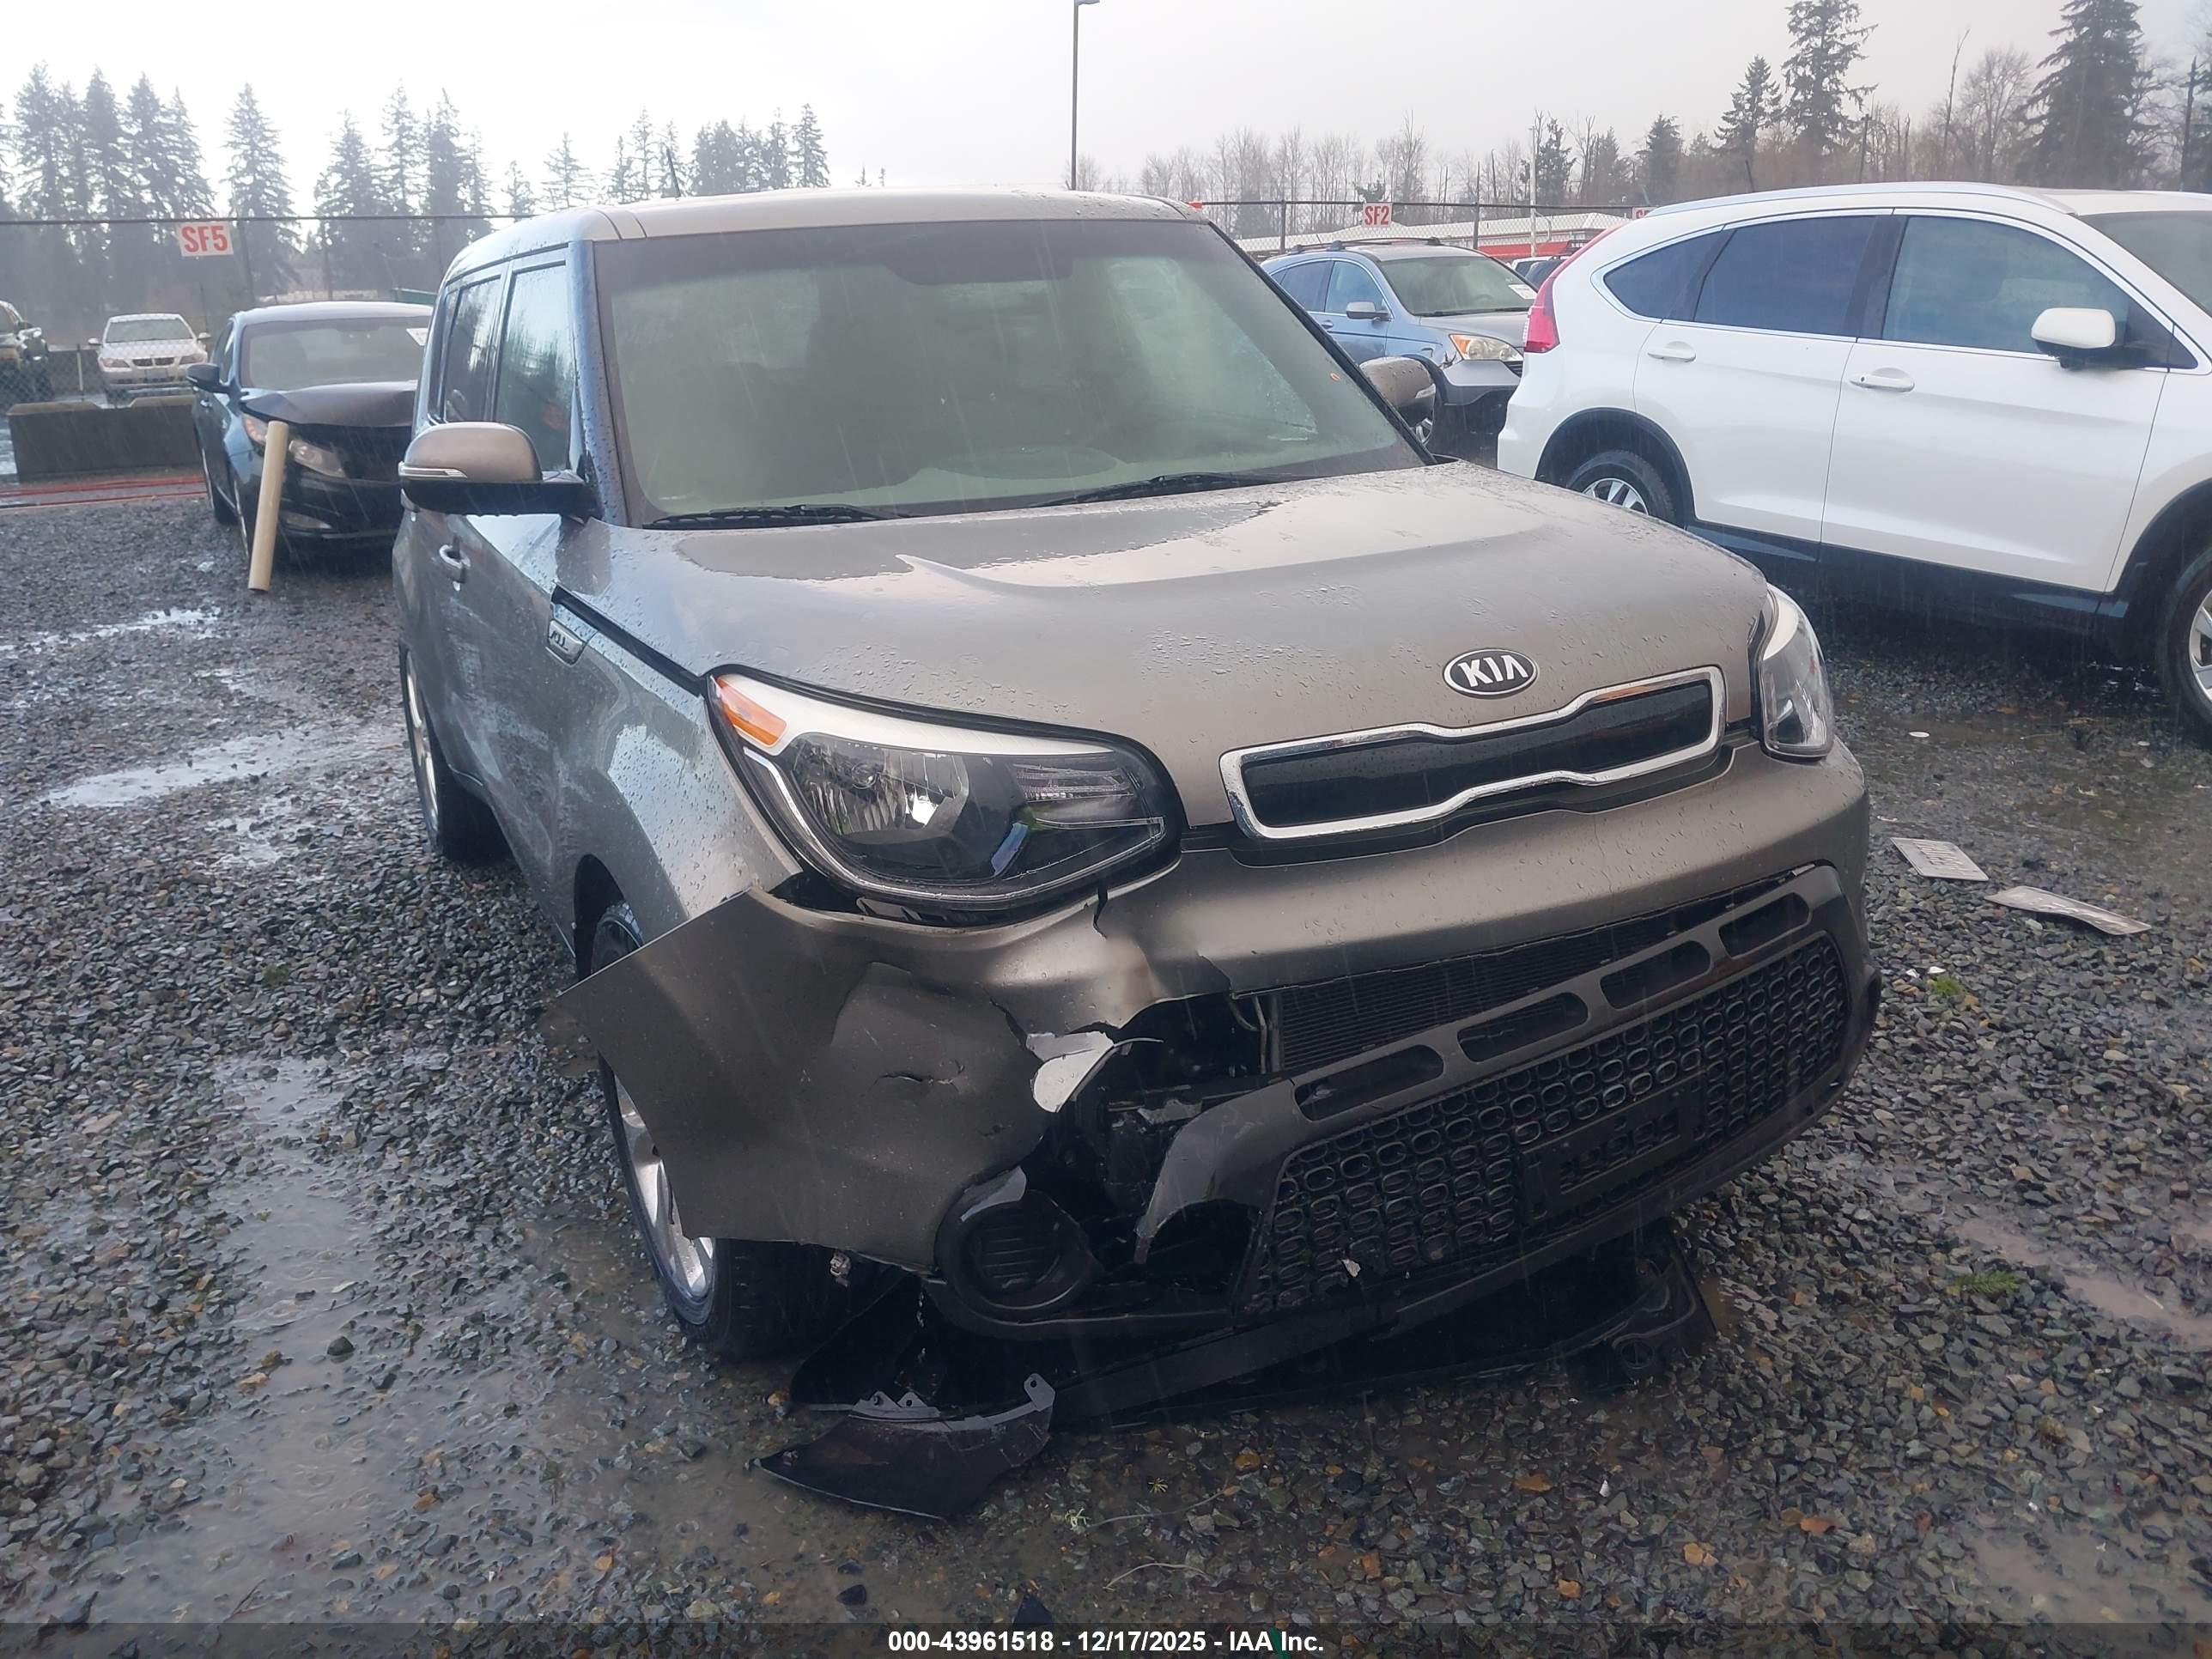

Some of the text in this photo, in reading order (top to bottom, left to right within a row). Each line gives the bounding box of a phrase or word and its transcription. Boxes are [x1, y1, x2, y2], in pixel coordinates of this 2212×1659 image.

[1364, 205, 1389, 225] SF2
[181, 225, 228, 253] SF5
[1456, 653, 1529, 688] KIA
